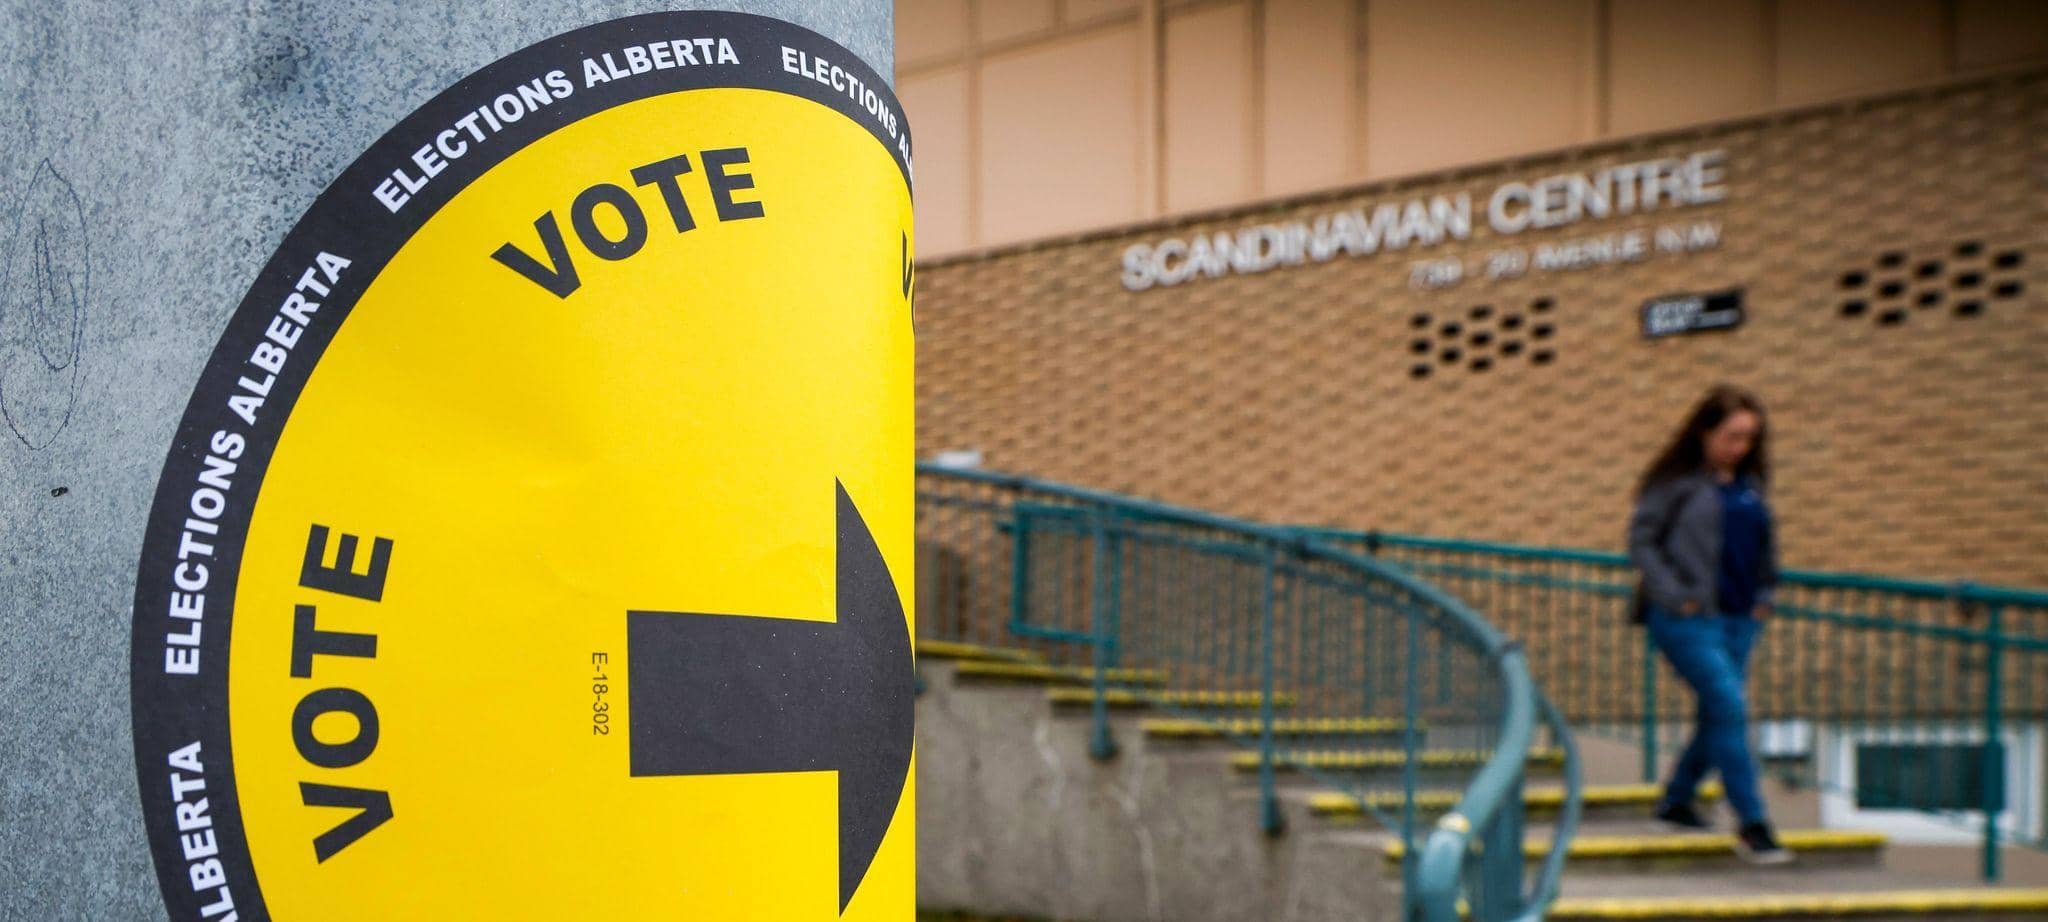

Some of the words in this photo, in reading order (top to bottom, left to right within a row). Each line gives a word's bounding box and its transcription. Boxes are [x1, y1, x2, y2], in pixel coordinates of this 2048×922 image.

[372, 70, 574, 214] ELECTIONS
[583, 38, 740, 89] ALBERTA
[781, 46, 897, 139] ELECTIONS
[491, 147, 765, 299] VOTE
[1120, 194, 1472, 291] SCANDINAVIAN
[1488, 150, 1729, 234] CENTRE
[1533, 230, 1646, 269] AVENUE
[165, 430, 245, 675] ELECTIONS
[228, 250, 352, 425] ALBERTA
[290, 523, 394, 864] VOTE
[592, 652, 609, 736] E-18-302
